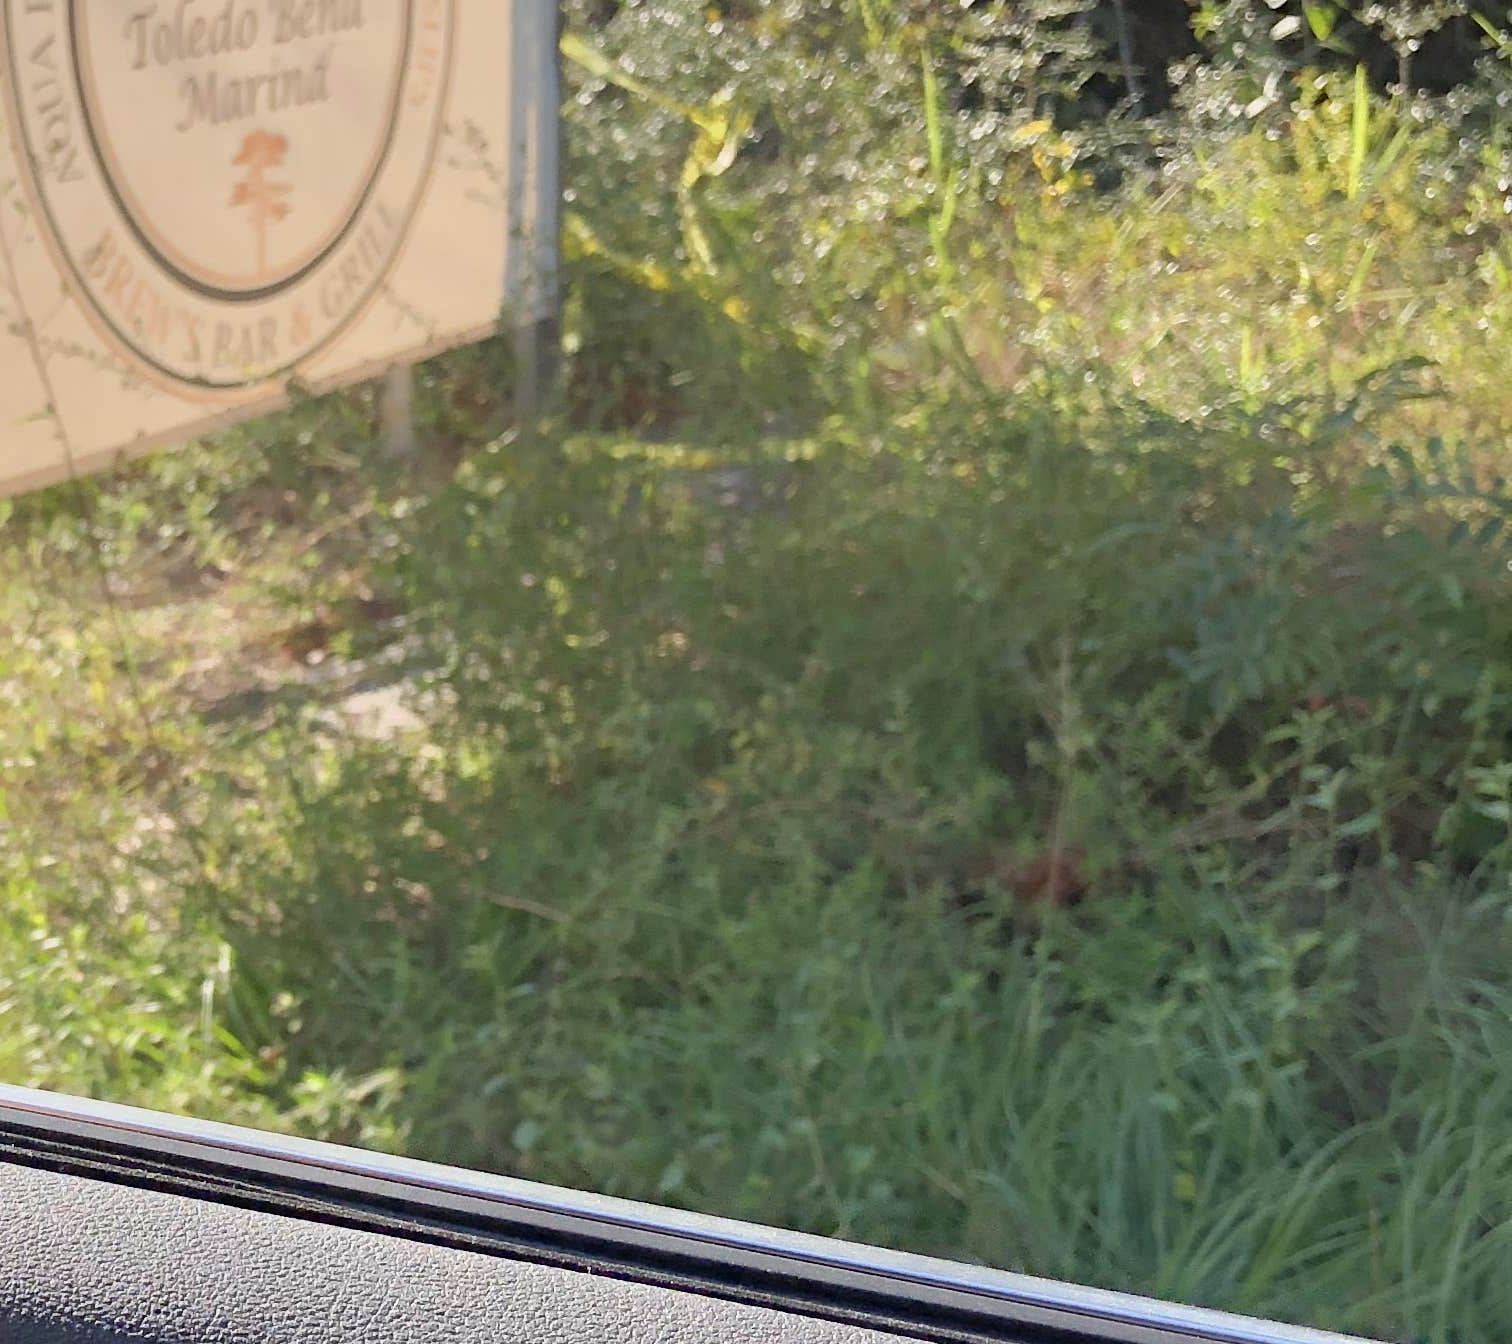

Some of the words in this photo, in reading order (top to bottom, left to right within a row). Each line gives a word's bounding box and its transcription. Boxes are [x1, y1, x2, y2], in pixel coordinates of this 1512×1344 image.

[29, 33, 85, 183] AQUA
[175, 42, 335, 132] Marina
[213, 316, 279, 367] BAR
